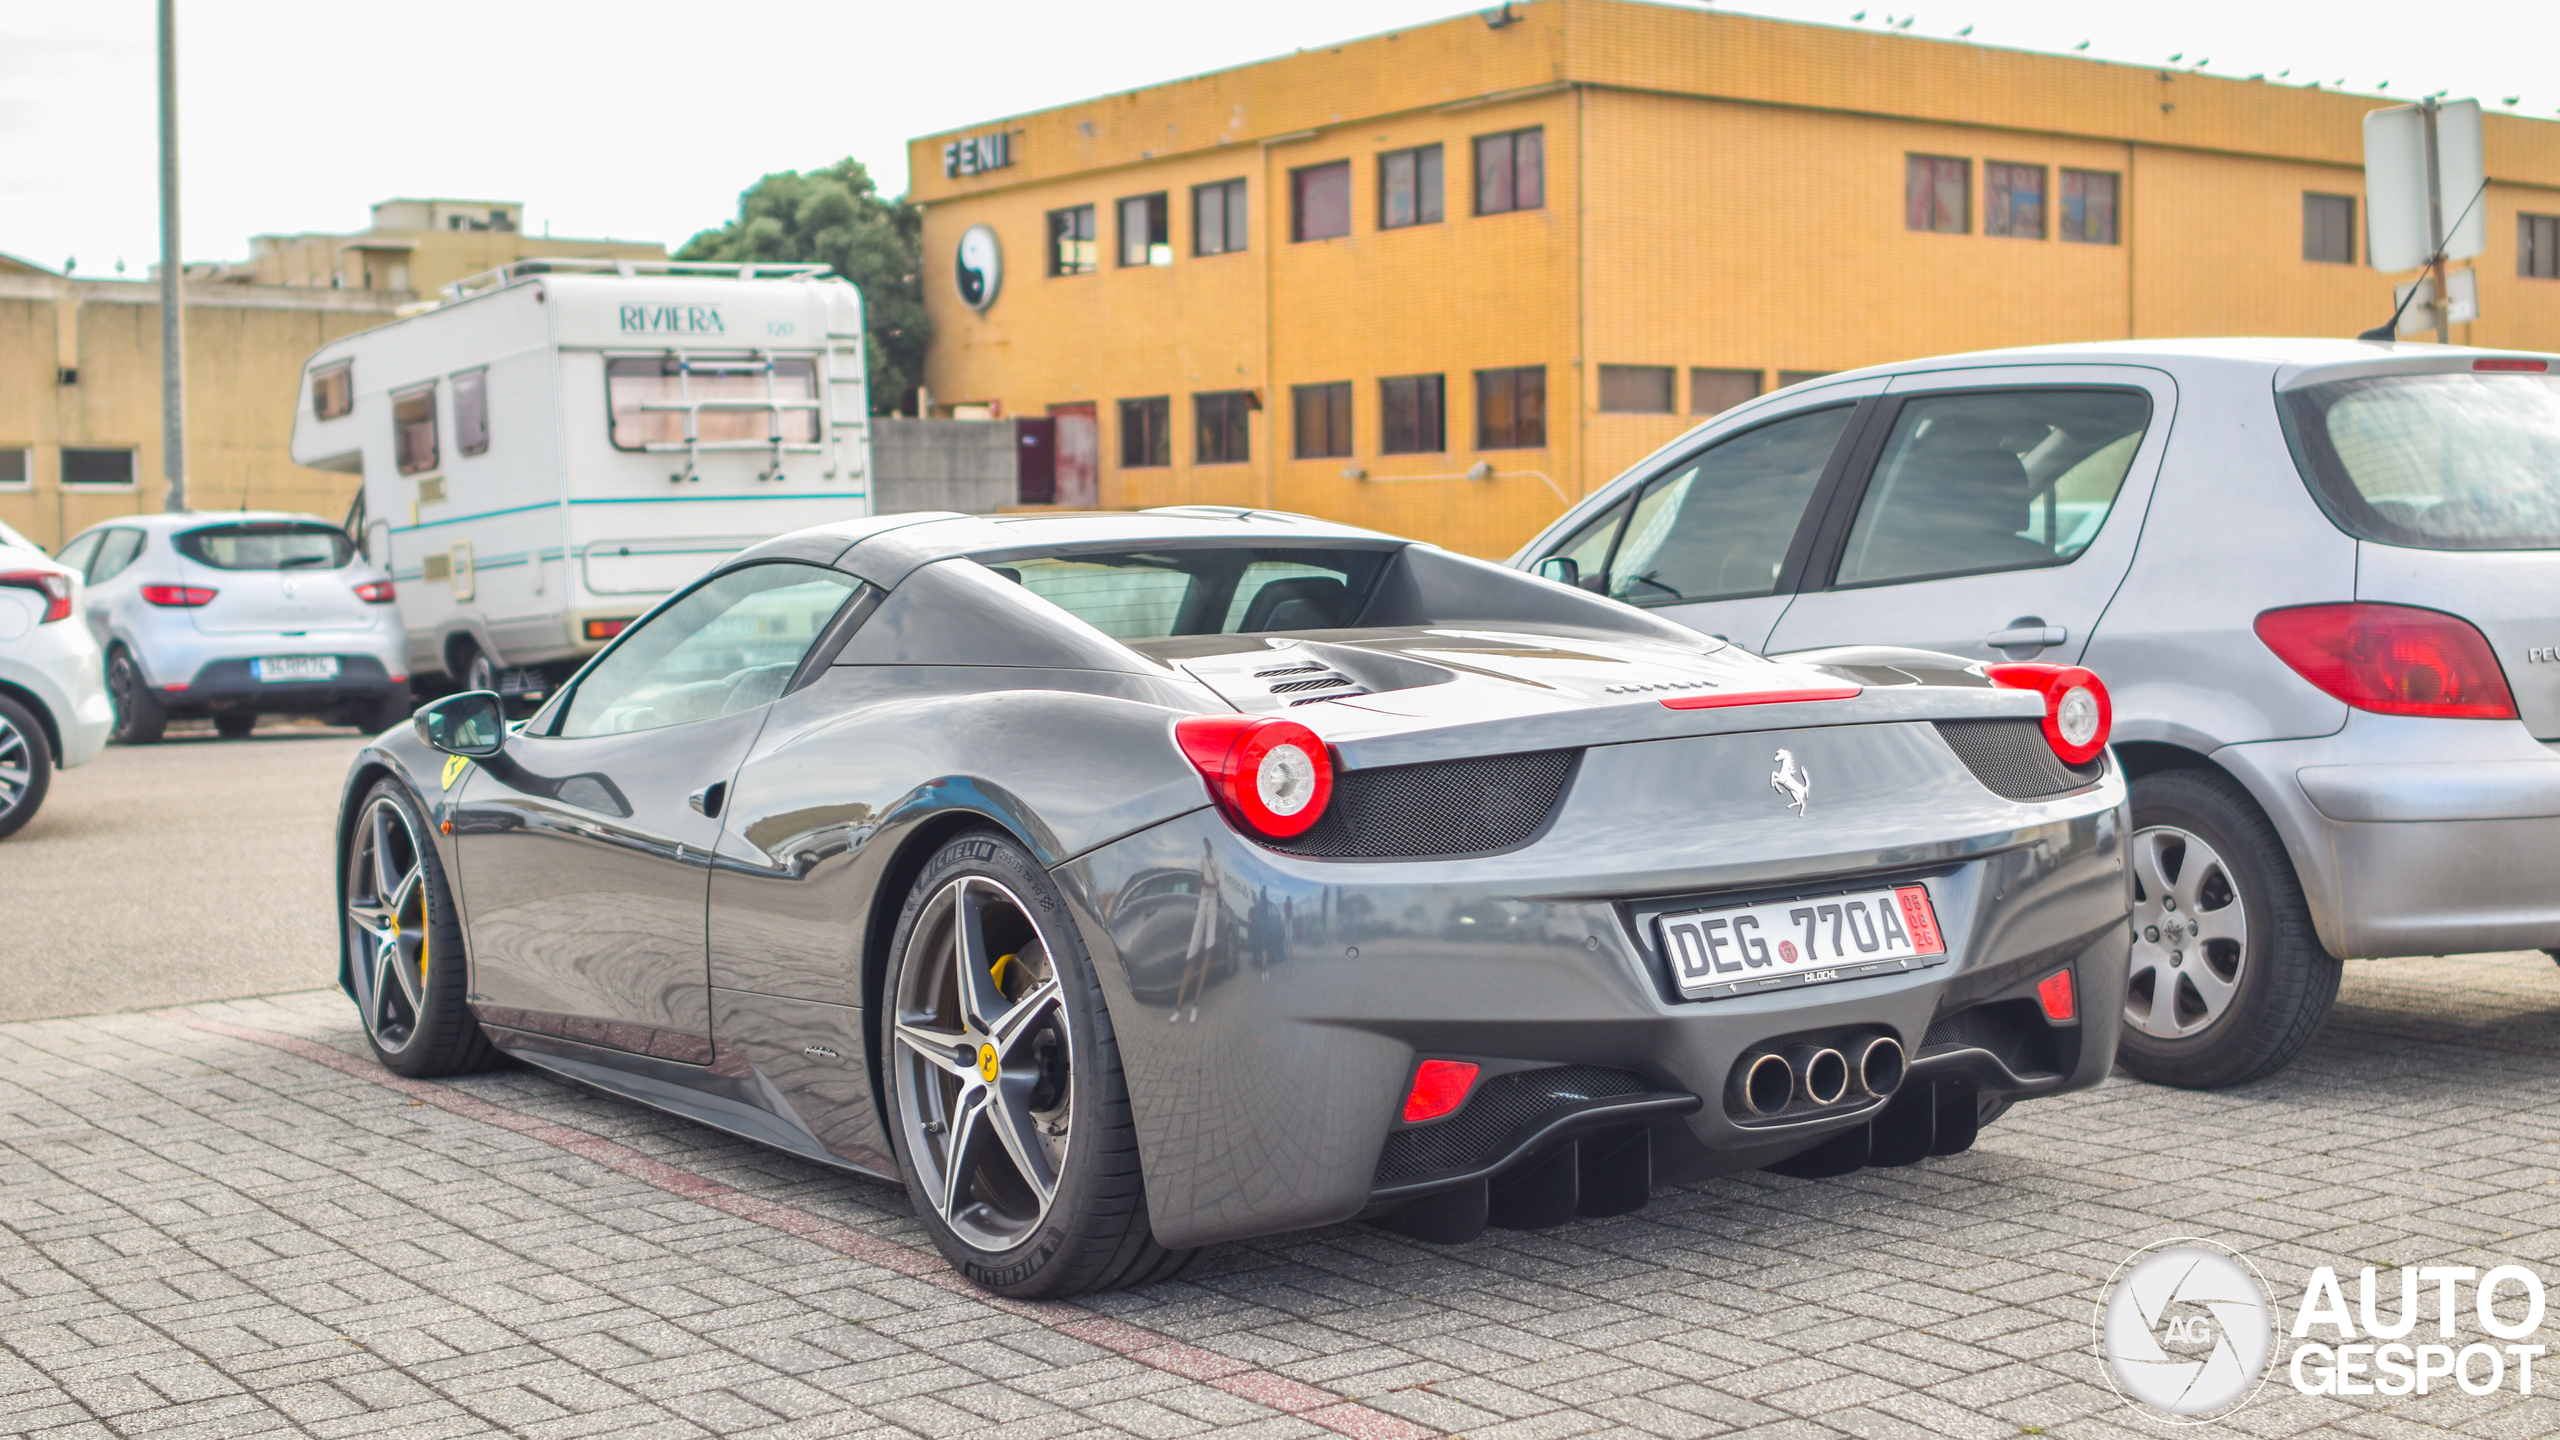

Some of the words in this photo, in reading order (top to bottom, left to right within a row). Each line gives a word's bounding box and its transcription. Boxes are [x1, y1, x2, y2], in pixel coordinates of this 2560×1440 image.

[619, 304, 724, 332] RIVIERA
[920, 841, 992, 887] MICHELIN
[999, 850, 1024, 873] 295/35
[1022, 871, 1032, 884] ZR
[1903, 894, 1922, 911] 05
[1670, 915, 1773, 978] DEG
[1914, 930, 1934, 947] 26
[968, 1248, 1045, 1286] MICHELIN
